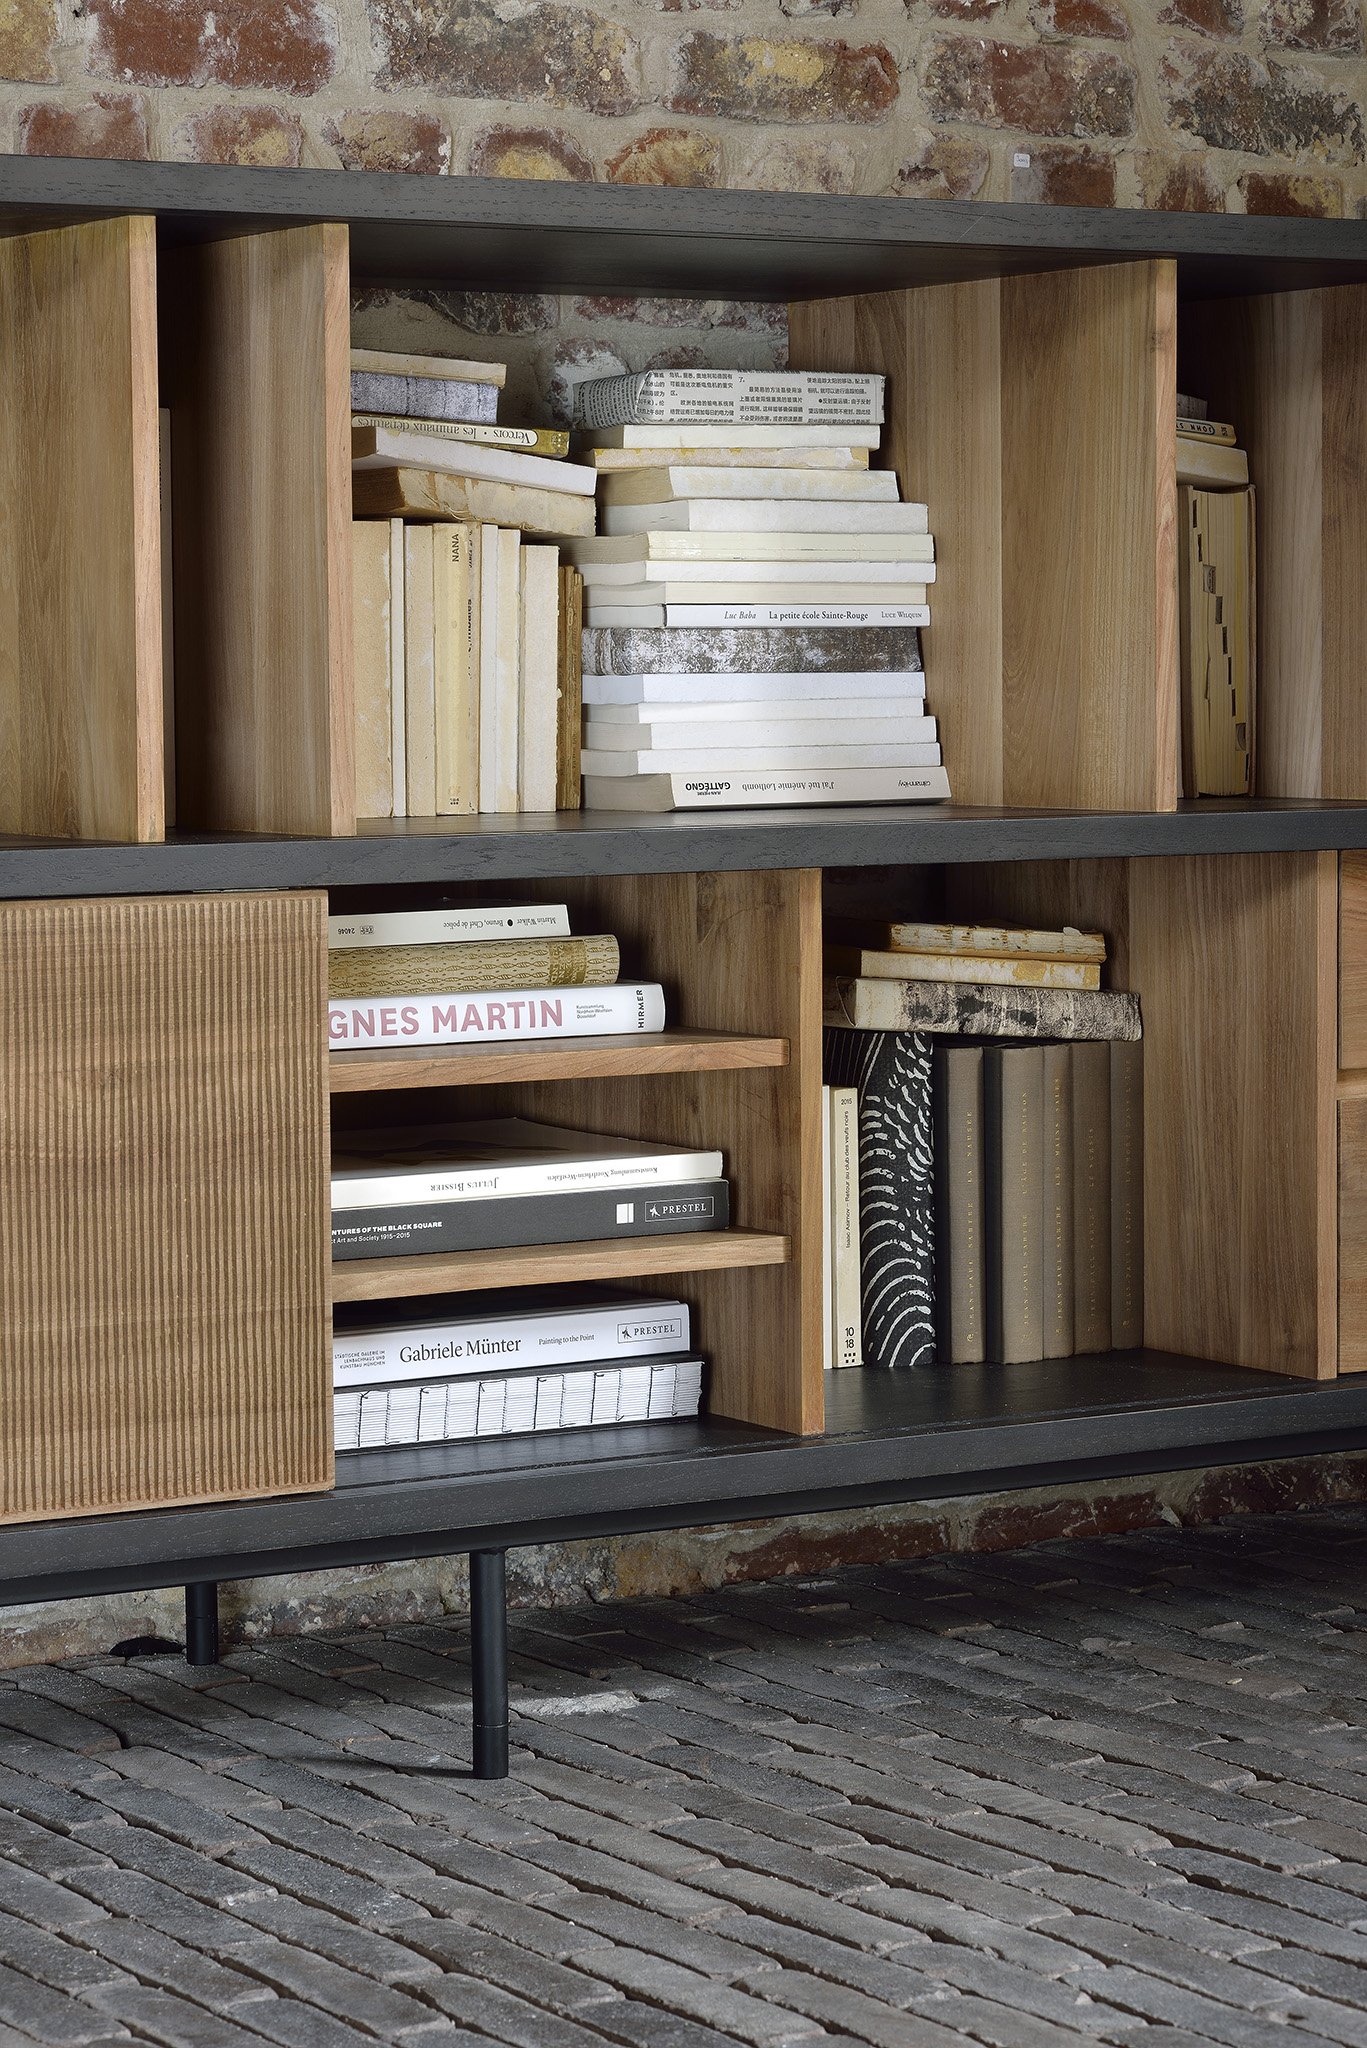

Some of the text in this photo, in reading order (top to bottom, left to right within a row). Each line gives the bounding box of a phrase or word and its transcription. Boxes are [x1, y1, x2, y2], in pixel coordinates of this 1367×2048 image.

[413, 422, 460, 437] animaux
[462, 426, 477, 440] les
[1190, 424, 1212, 432] JOHN
[493, 429, 531, 444] Vercors
[451, 533, 460, 563] NANA
[724, 612, 738, 620] Luc
[739, 611, 757, 620] Baba
[769, 611, 778, 620] La
[780, 611, 800, 621] petite
[802, 611, 820, 620] école
[822, 611, 869, 621] Sainte-Rouge
[685, 782, 731, 792] GATTÉGNO
[778, 781, 806, 791] Anémie
[808, 781, 820, 790] tué
[443, 920, 460, 930] police
[469, 920, 484, 929] Chef
[484, 919, 503, 927] Bruno,
[516, 918, 536, 926] Walker
[537, 916, 556, 925] Martin
[636, 989, 645, 1029] HIRMER
[432, 999, 563, 1034] MARTIN
[845, 1172, 850, 1180] au
[967, 1169, 973, 1184] LA
[662, 1202, 707, 1214] PRESTEL
[372, 1225, 388, 1233] THE
[388, 1224, 413, 1232] BLACK
[413, 1221, 443, 1230] SQUARE
[358, 1234, 380, 1242] Society
[634, 1324, 676, 1337] PRESTEL
[845, 1326, 855, 1337] 10
[538, 1335, 562, 1346] Painting
[569, 1335, 579, 1343] the
[579, 1334, 595, 1342] Point
[845, 1338, 855, 1349] 18
[400, 1338, 522, 1363] Gabriele Münter
